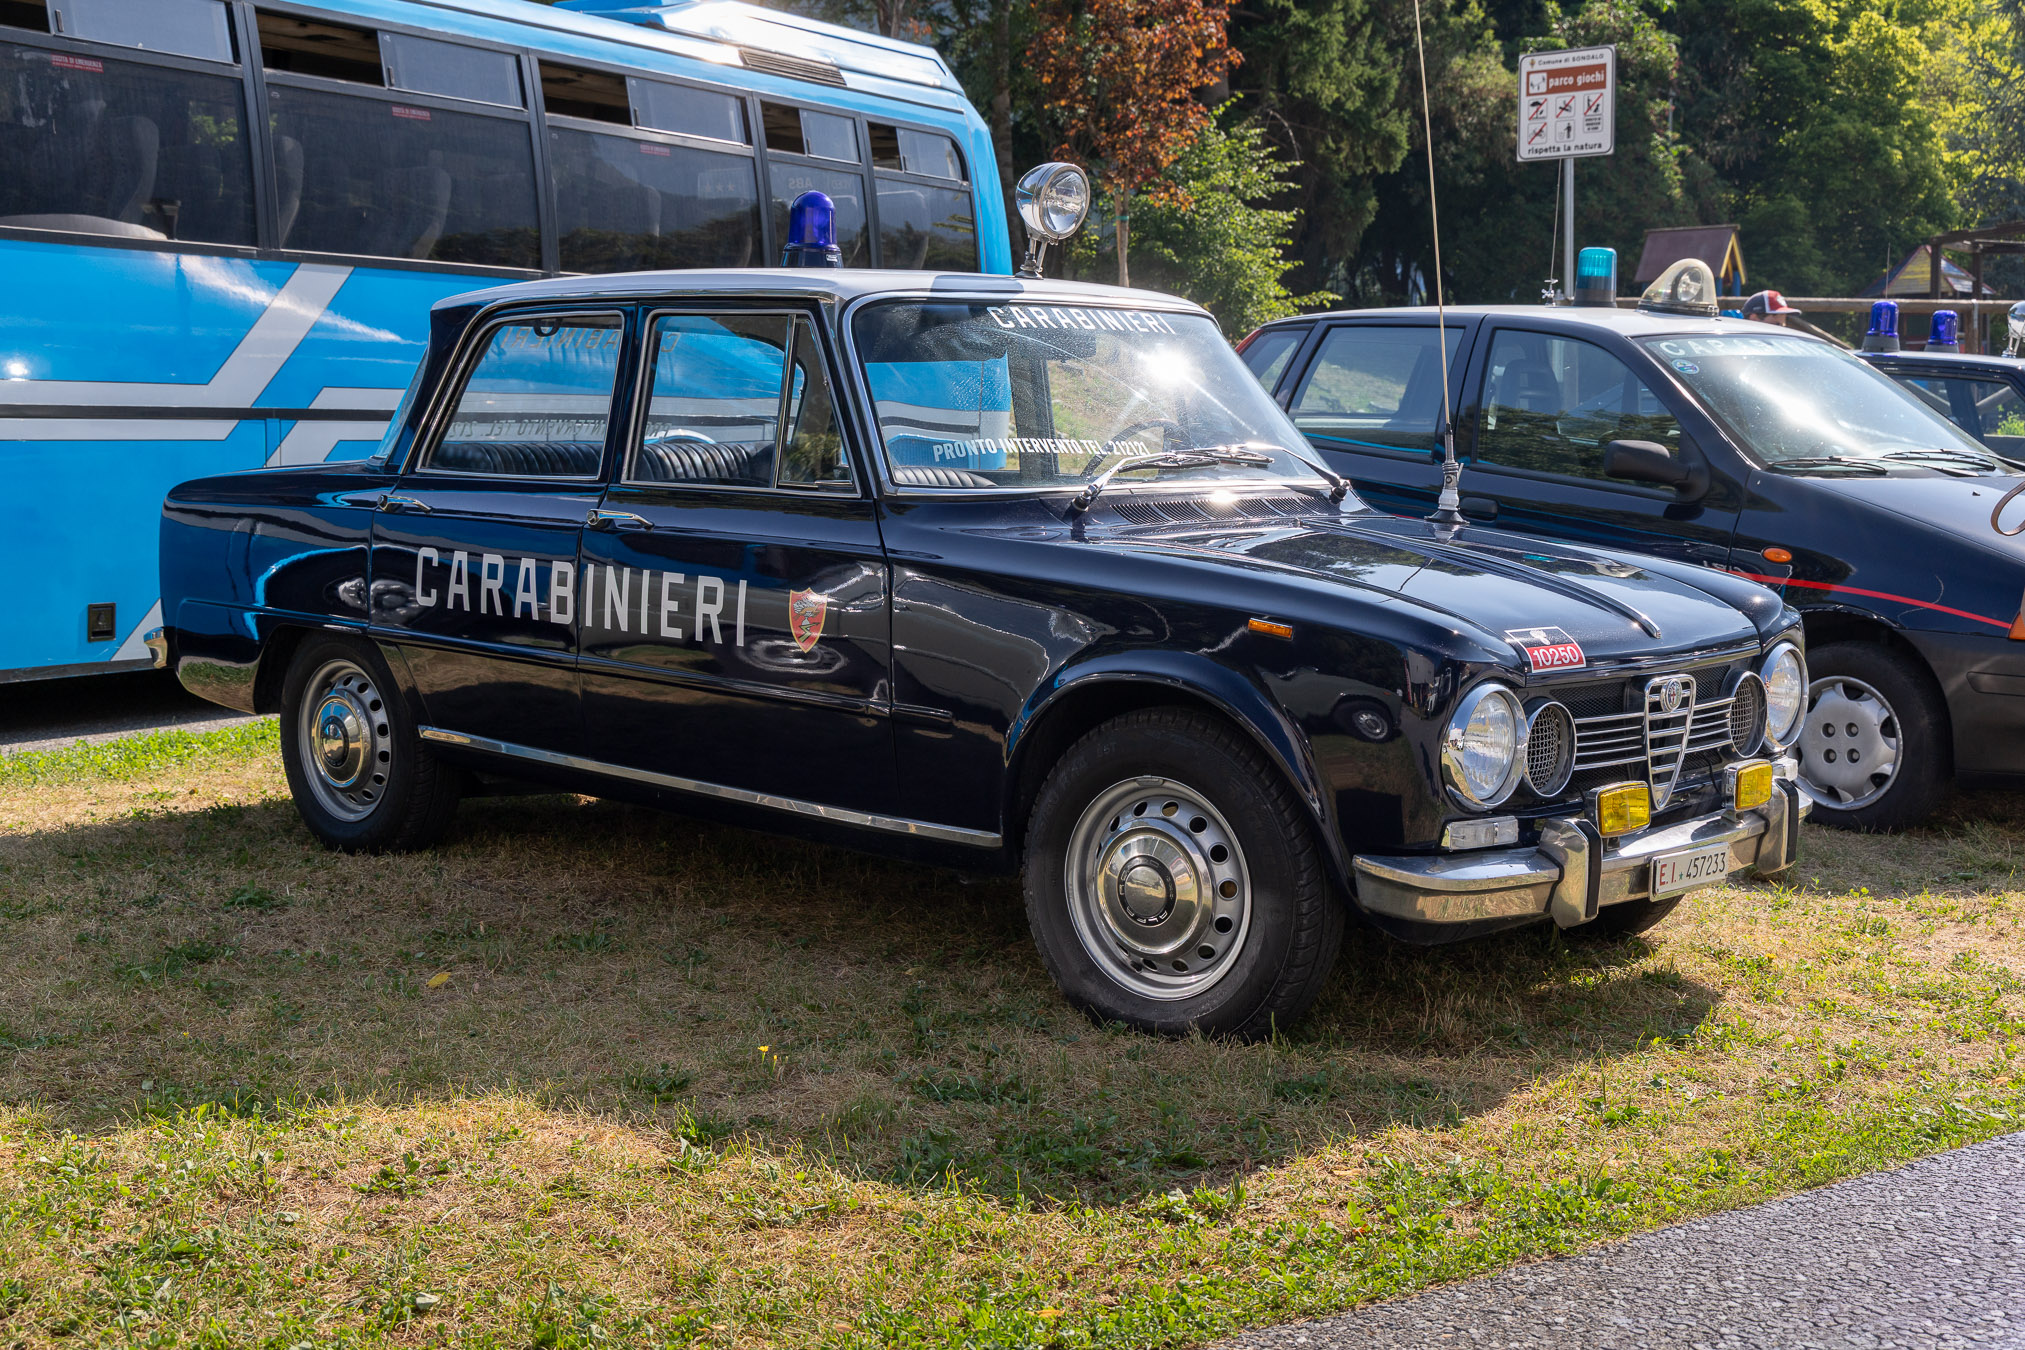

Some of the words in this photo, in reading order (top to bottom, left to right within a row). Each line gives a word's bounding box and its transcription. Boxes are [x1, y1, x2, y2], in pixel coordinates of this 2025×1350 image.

[1549, 75, 1575, 89] parco
[1576, 70, 1605, 87] giochi
[1528, 145, 1561, 155] rispetta
[1563, 144, 1571, 152] la
[1574, 142, 1602, 151] natura
[986, 306, 1176, 335] CARABINIERI
[932, 438, 998, 462] PRONTO
[998, 437, 1083, 455] INTERVENTO
[1081, 439, 1111, 456] TEL.
[1109, 440, 1150, 457] 212121
[415, 547, 748, 648] CARABINIERI
[1532, 645, 1579, 667] 10250
[1685, 852, 1726, 880] 457233
